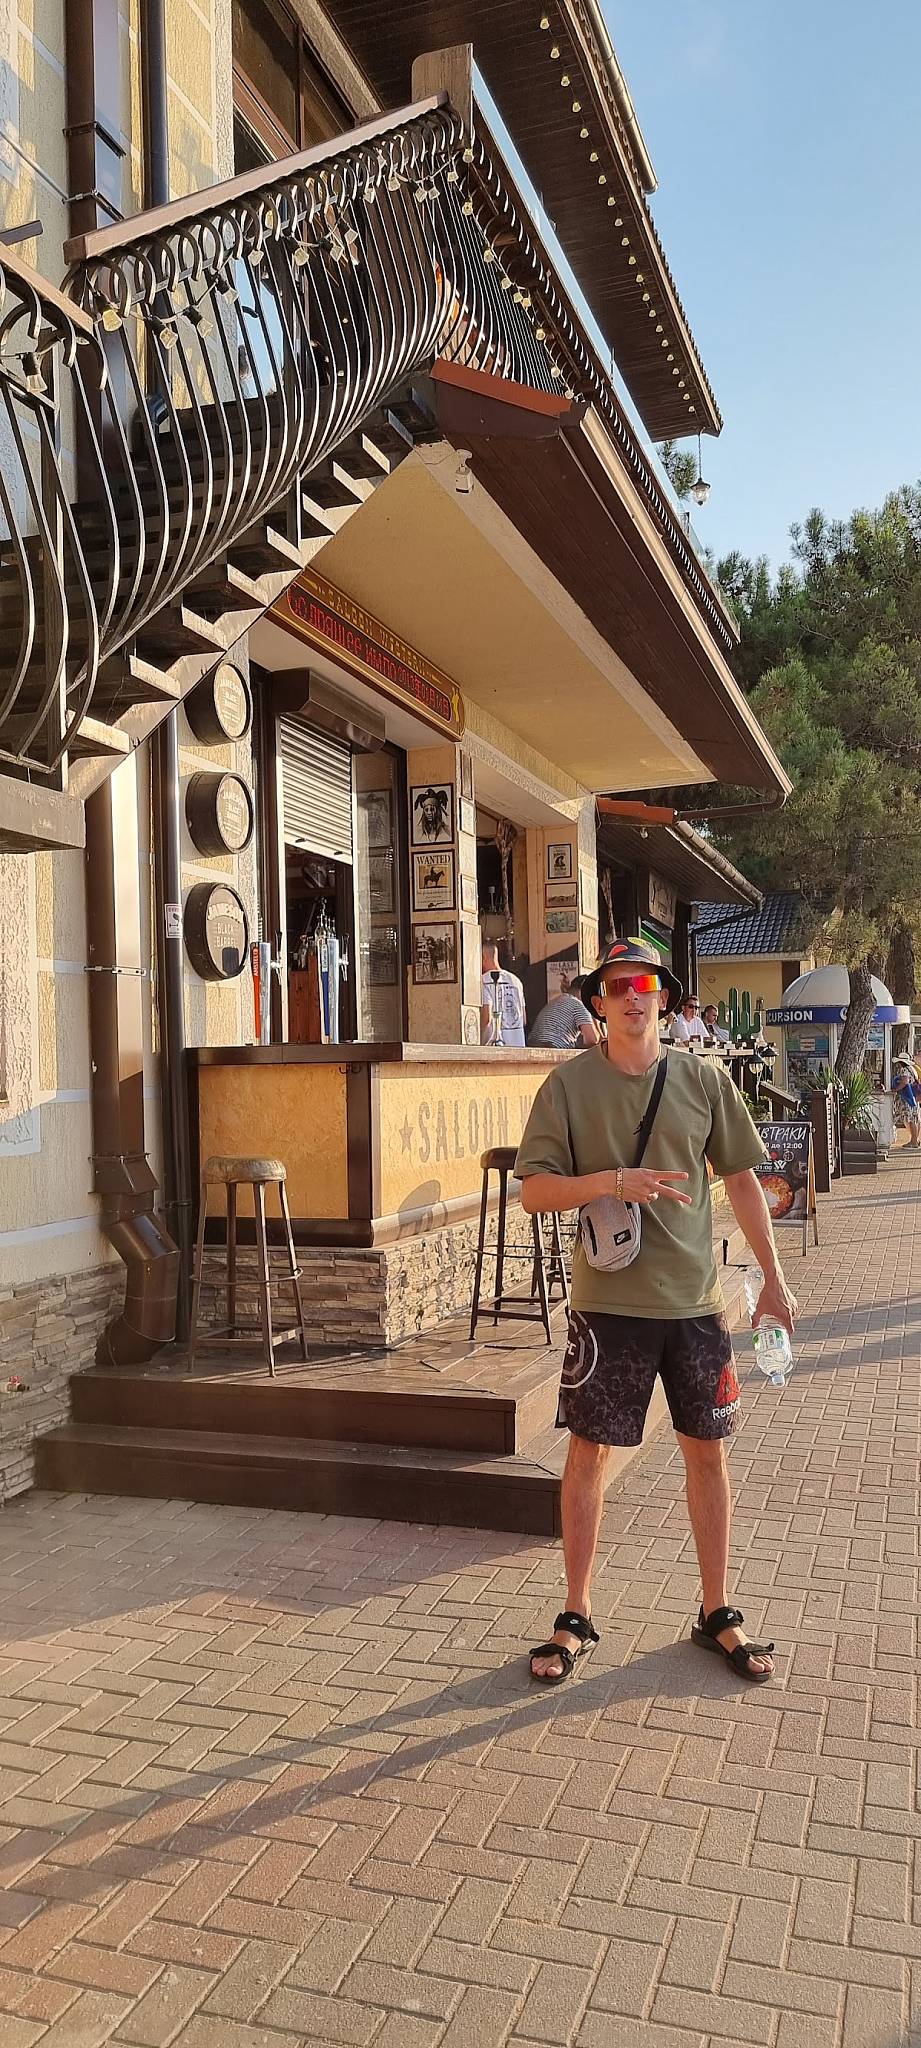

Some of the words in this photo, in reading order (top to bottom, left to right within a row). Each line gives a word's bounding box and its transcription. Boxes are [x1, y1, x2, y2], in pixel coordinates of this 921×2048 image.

[416, 855, 451, 864] WANTED
[207, 903, 244, 924] JAMESON
[217, 923, 234, 936] BLACK
[418, 1097, 509, 1163] SALOON
[758, 1126, 807, 1141] ВТРАКИ
